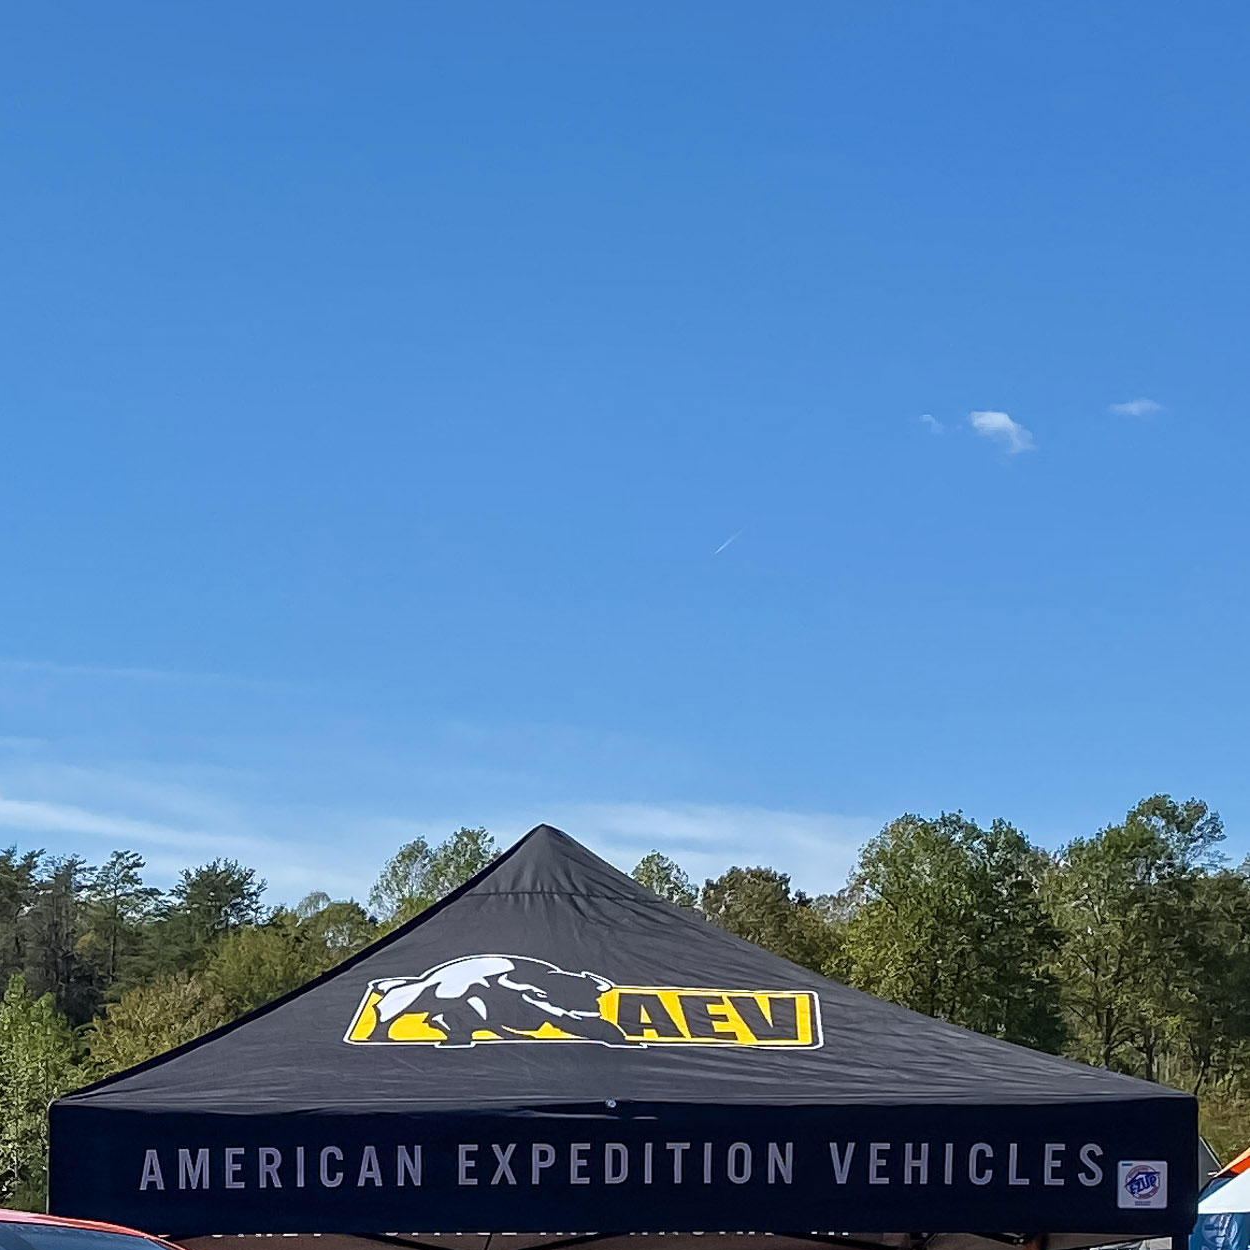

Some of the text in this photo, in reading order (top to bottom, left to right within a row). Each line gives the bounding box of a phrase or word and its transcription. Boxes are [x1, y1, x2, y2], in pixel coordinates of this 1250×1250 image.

[618, 992, 799, 1041] AEV
[138, 1142, 1104, 1190] AMERICAN EXPEDITION VEHICLES
